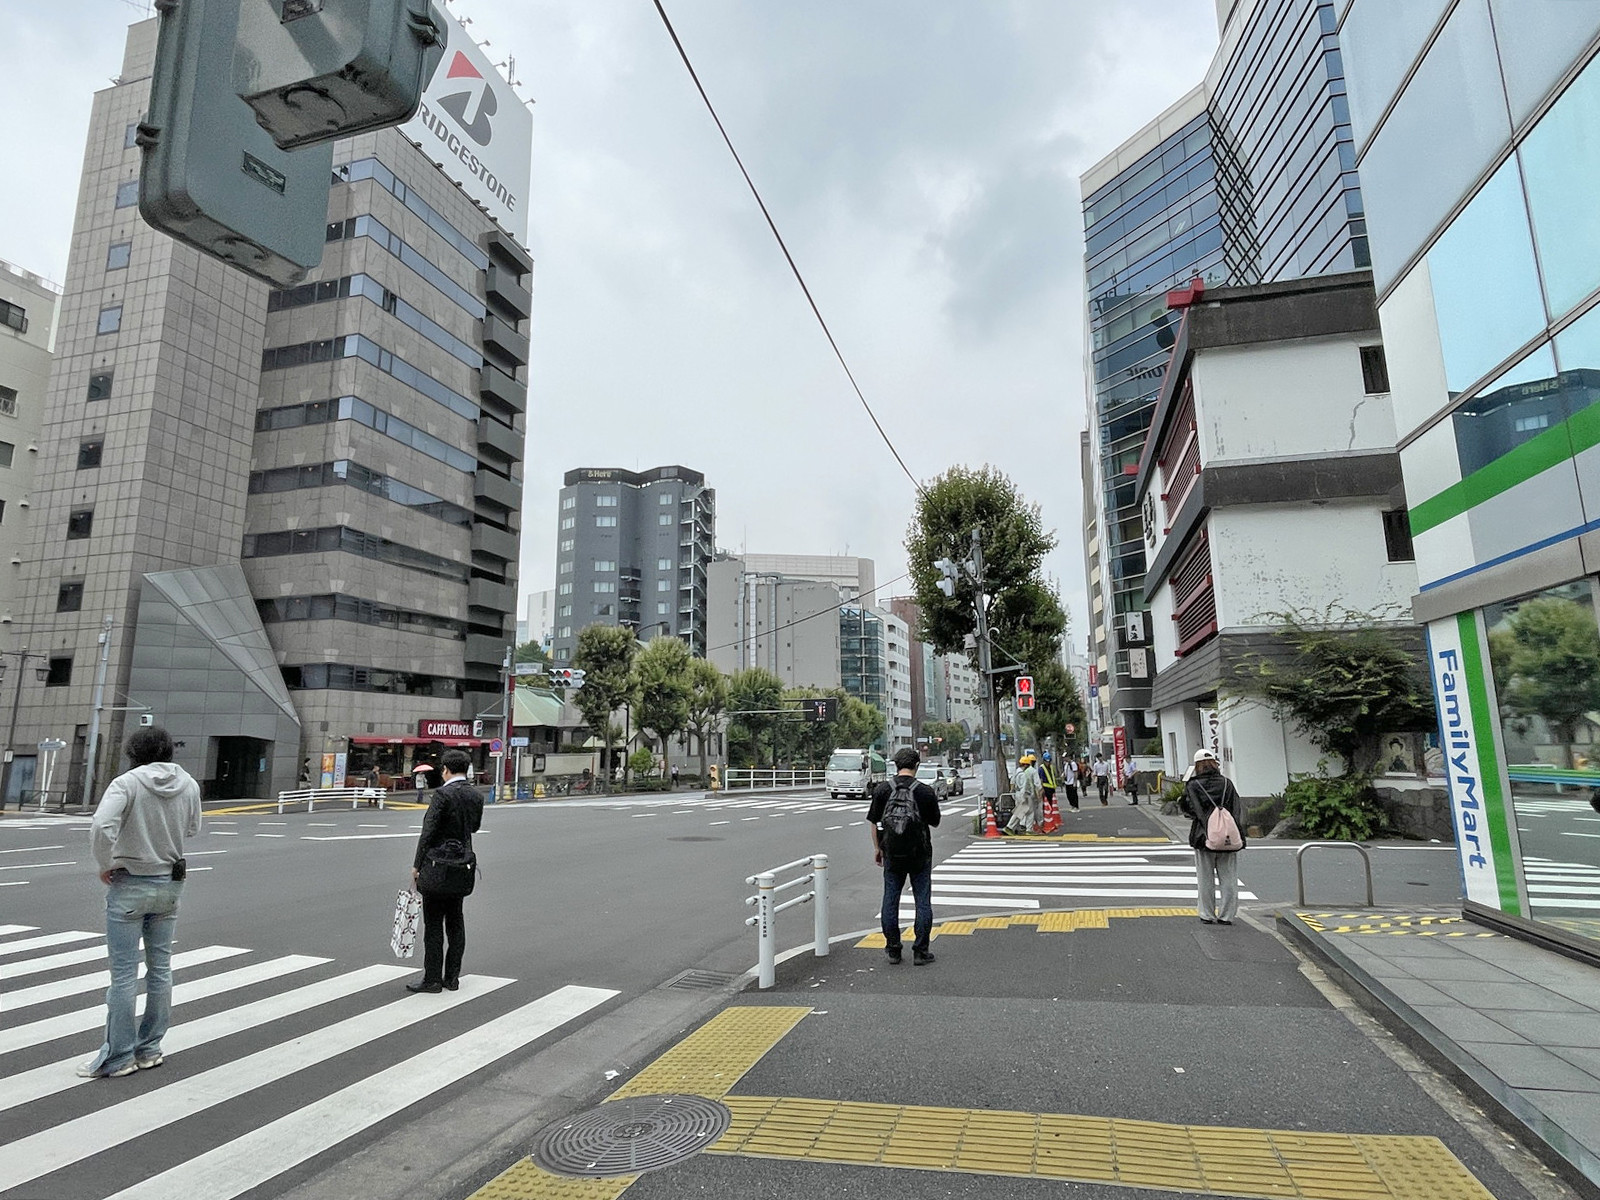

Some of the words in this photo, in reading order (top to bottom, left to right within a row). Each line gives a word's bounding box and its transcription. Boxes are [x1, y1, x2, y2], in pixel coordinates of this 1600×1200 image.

[417, 101, 516, 212] RIDGESTONE
[427, 723, 447, 735] CAFFE
[448, 724, 470, 736] VELOCE
[1439, 649, 1487, 870] FamilyMart
